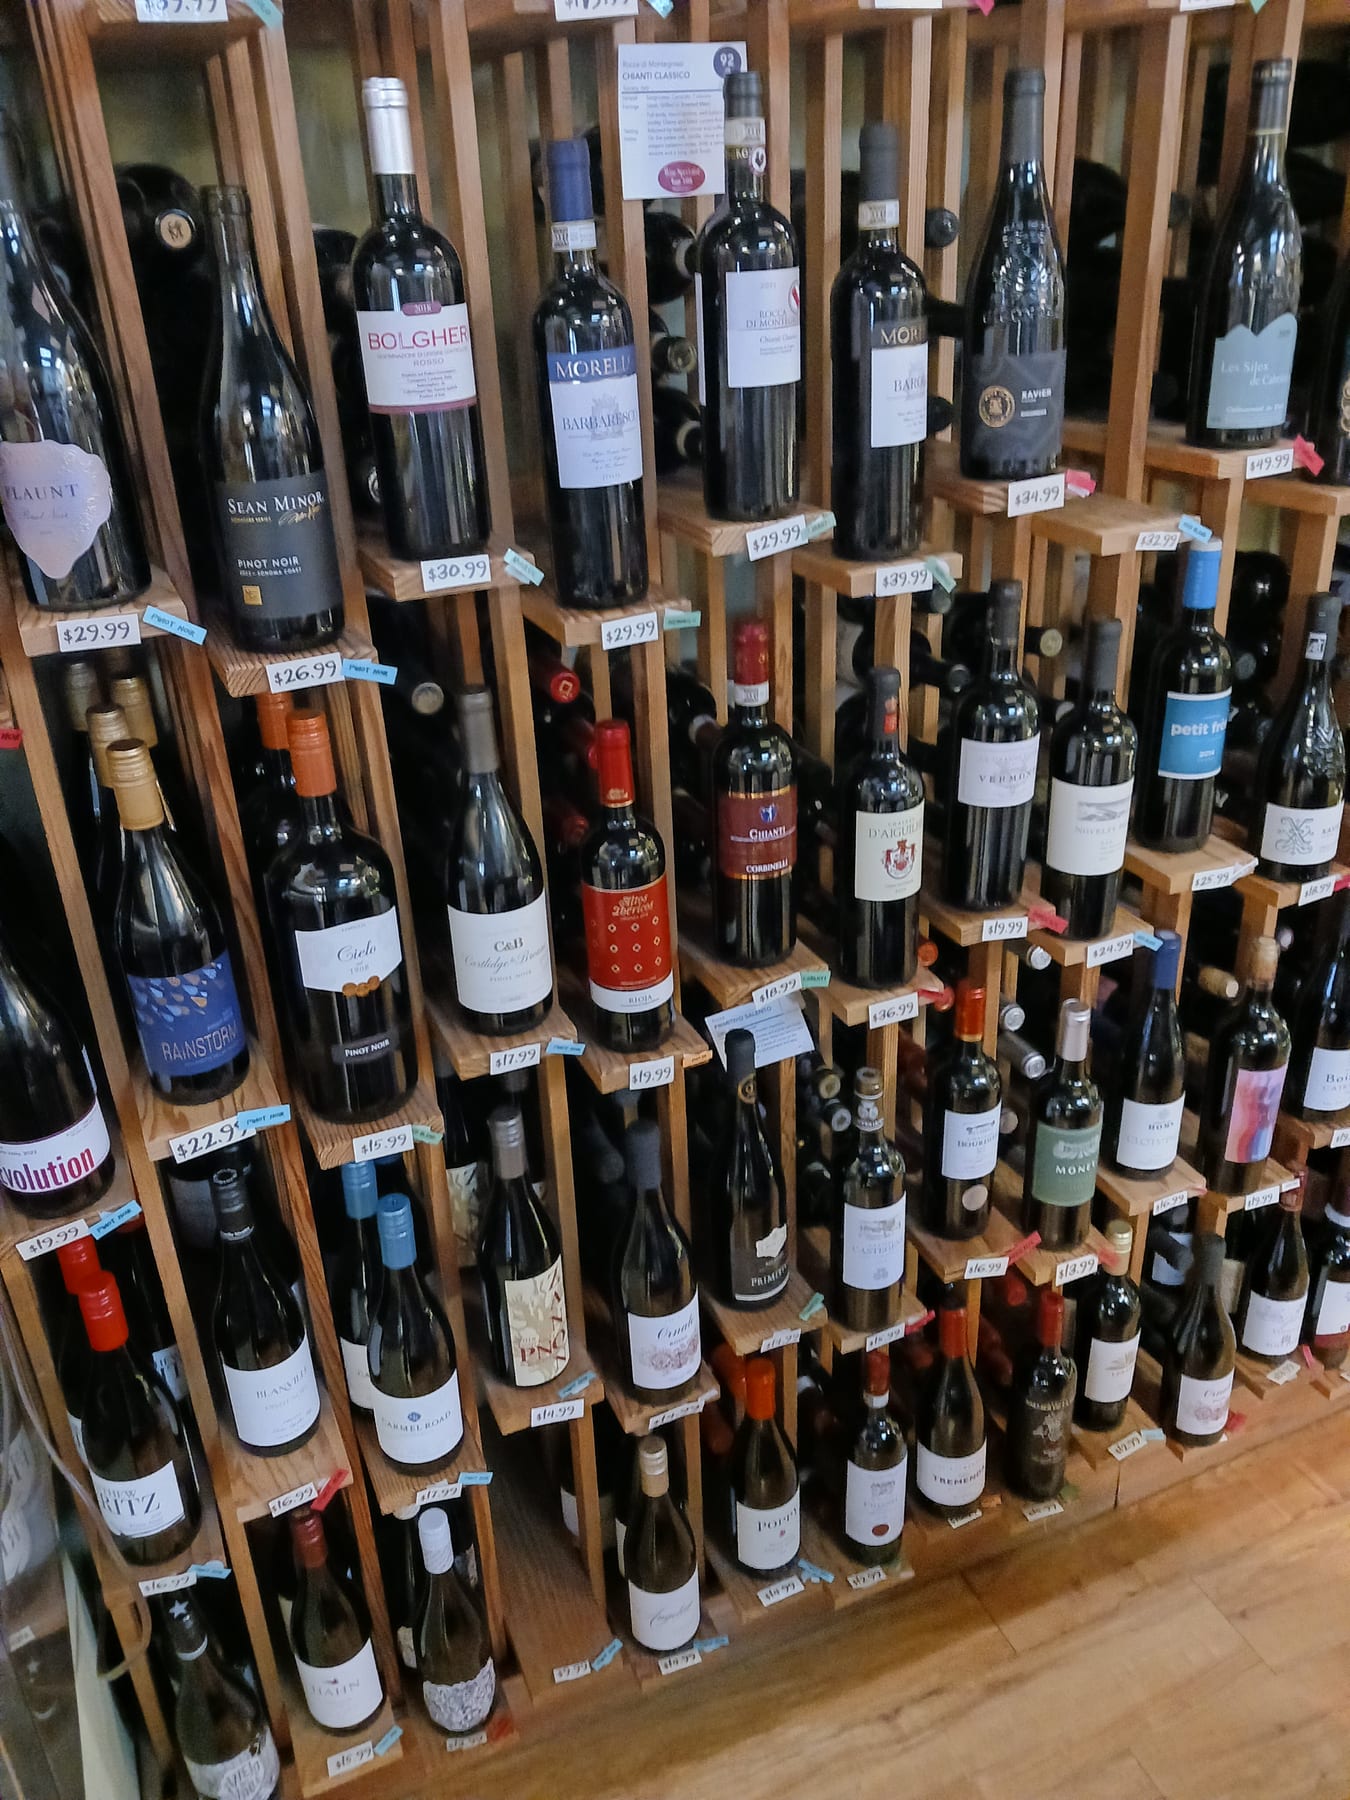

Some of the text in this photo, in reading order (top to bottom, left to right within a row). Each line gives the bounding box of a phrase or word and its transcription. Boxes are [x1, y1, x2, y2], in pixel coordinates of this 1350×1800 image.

[720, 53, 734, 67] 92
[622, 71, 690, 81] CHIANTI CLASSICO
[746, 320, 757, 329] DI
[413, 358, 445, 367] ROSSO
[1250, 454, 1290, 474] $49.99
[1014, 486, 1060, 506] $34.99
[752, 521, 801, 551] $29.99
[1140, 534, 1178, 548] $32.99
[237, 556, 300, 569] PINOT NOIR
[427, 559, 488, 583] $30.99
[883, 570, 928, 588] $39.99
[64, 621, 131, 645] $29.99
[606, 621, 655, 644] $29.99
[274, 660, 336, 687] $26.99
[1171, 722, 1209, 736] petit
[749, 826, 787, 840] CHIANTI
[746, 858, 788, 873] CORBINELLI
[987, 921, 1023, 936] $19.99
[337, 940, 377, 962] Cielo
[494, 937, 524, 953] C&B
[1093, 938, 1132, 957] $24.99
[628, 994, 653, 1004] RIOJA
[759, 980, 797, 1004] $18.99
[873, 1002, 914, 1023] $36.99
[345, 1039, 390, 1059] PINOT NOIR
[495, 1050, 537, 1068] $17.99
[632, 1067, 672, 1085] $19.99
[360, 1134, 407, 1154] $15.99
[29, 1226, 79, 1254] $19.99
[968, 1262, 1002, 1275] $16.99
[424, 1410, 452, 1430] ROAD
[272, 1489, 314, 1513] $16.99
